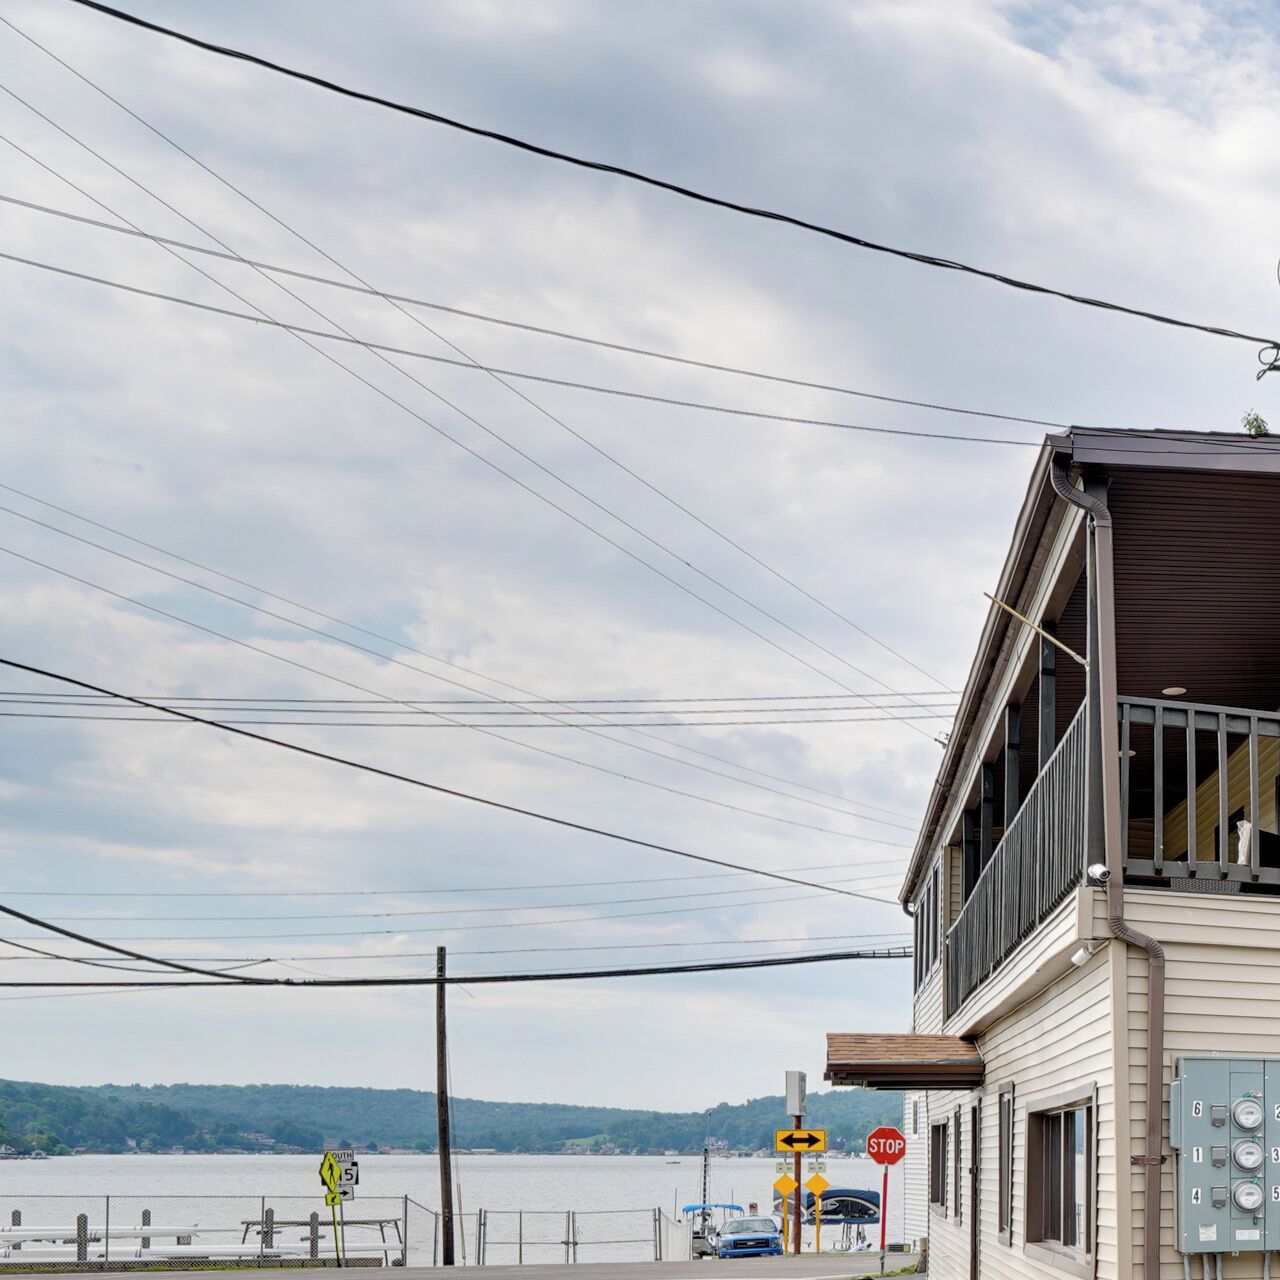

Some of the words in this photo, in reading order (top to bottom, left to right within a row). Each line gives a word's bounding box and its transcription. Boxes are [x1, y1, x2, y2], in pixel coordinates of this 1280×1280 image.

[1194, 1101, 1201, 1116] 6
[869, 1138, 904, 1154] STOP
[332, 1152, 352, 1160] OUTH
[1195, 1148, 1200, 1161] 1
[1273, 1148, 1280, 1162] 3
[1193, 1189, 1200, 1203] 4
[1273, 1186, 1280, 1200] 5
